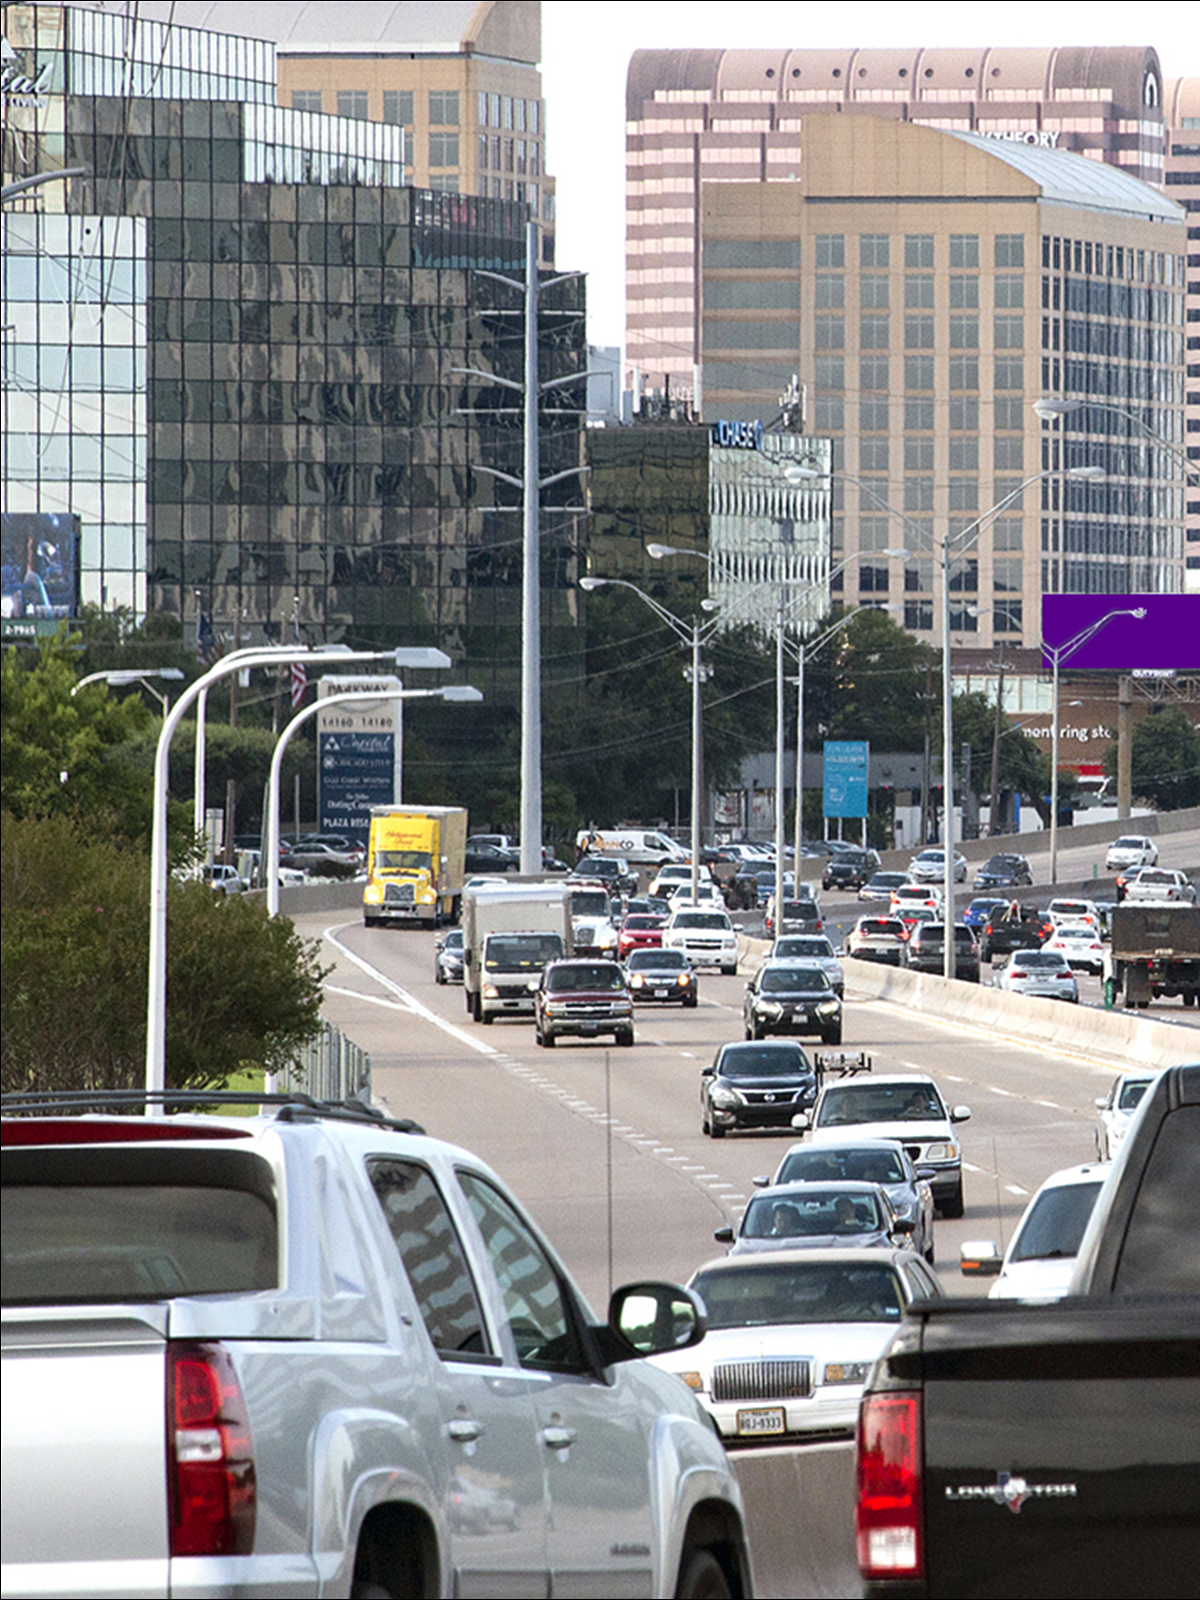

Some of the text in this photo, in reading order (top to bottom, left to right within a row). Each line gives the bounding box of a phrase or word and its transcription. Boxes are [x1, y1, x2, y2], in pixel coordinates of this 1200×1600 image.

[719, 419, 754, 447] CHASE
[1060, 723, 1089, 743] ring
[323, 818, 349, 828] PLAZA
